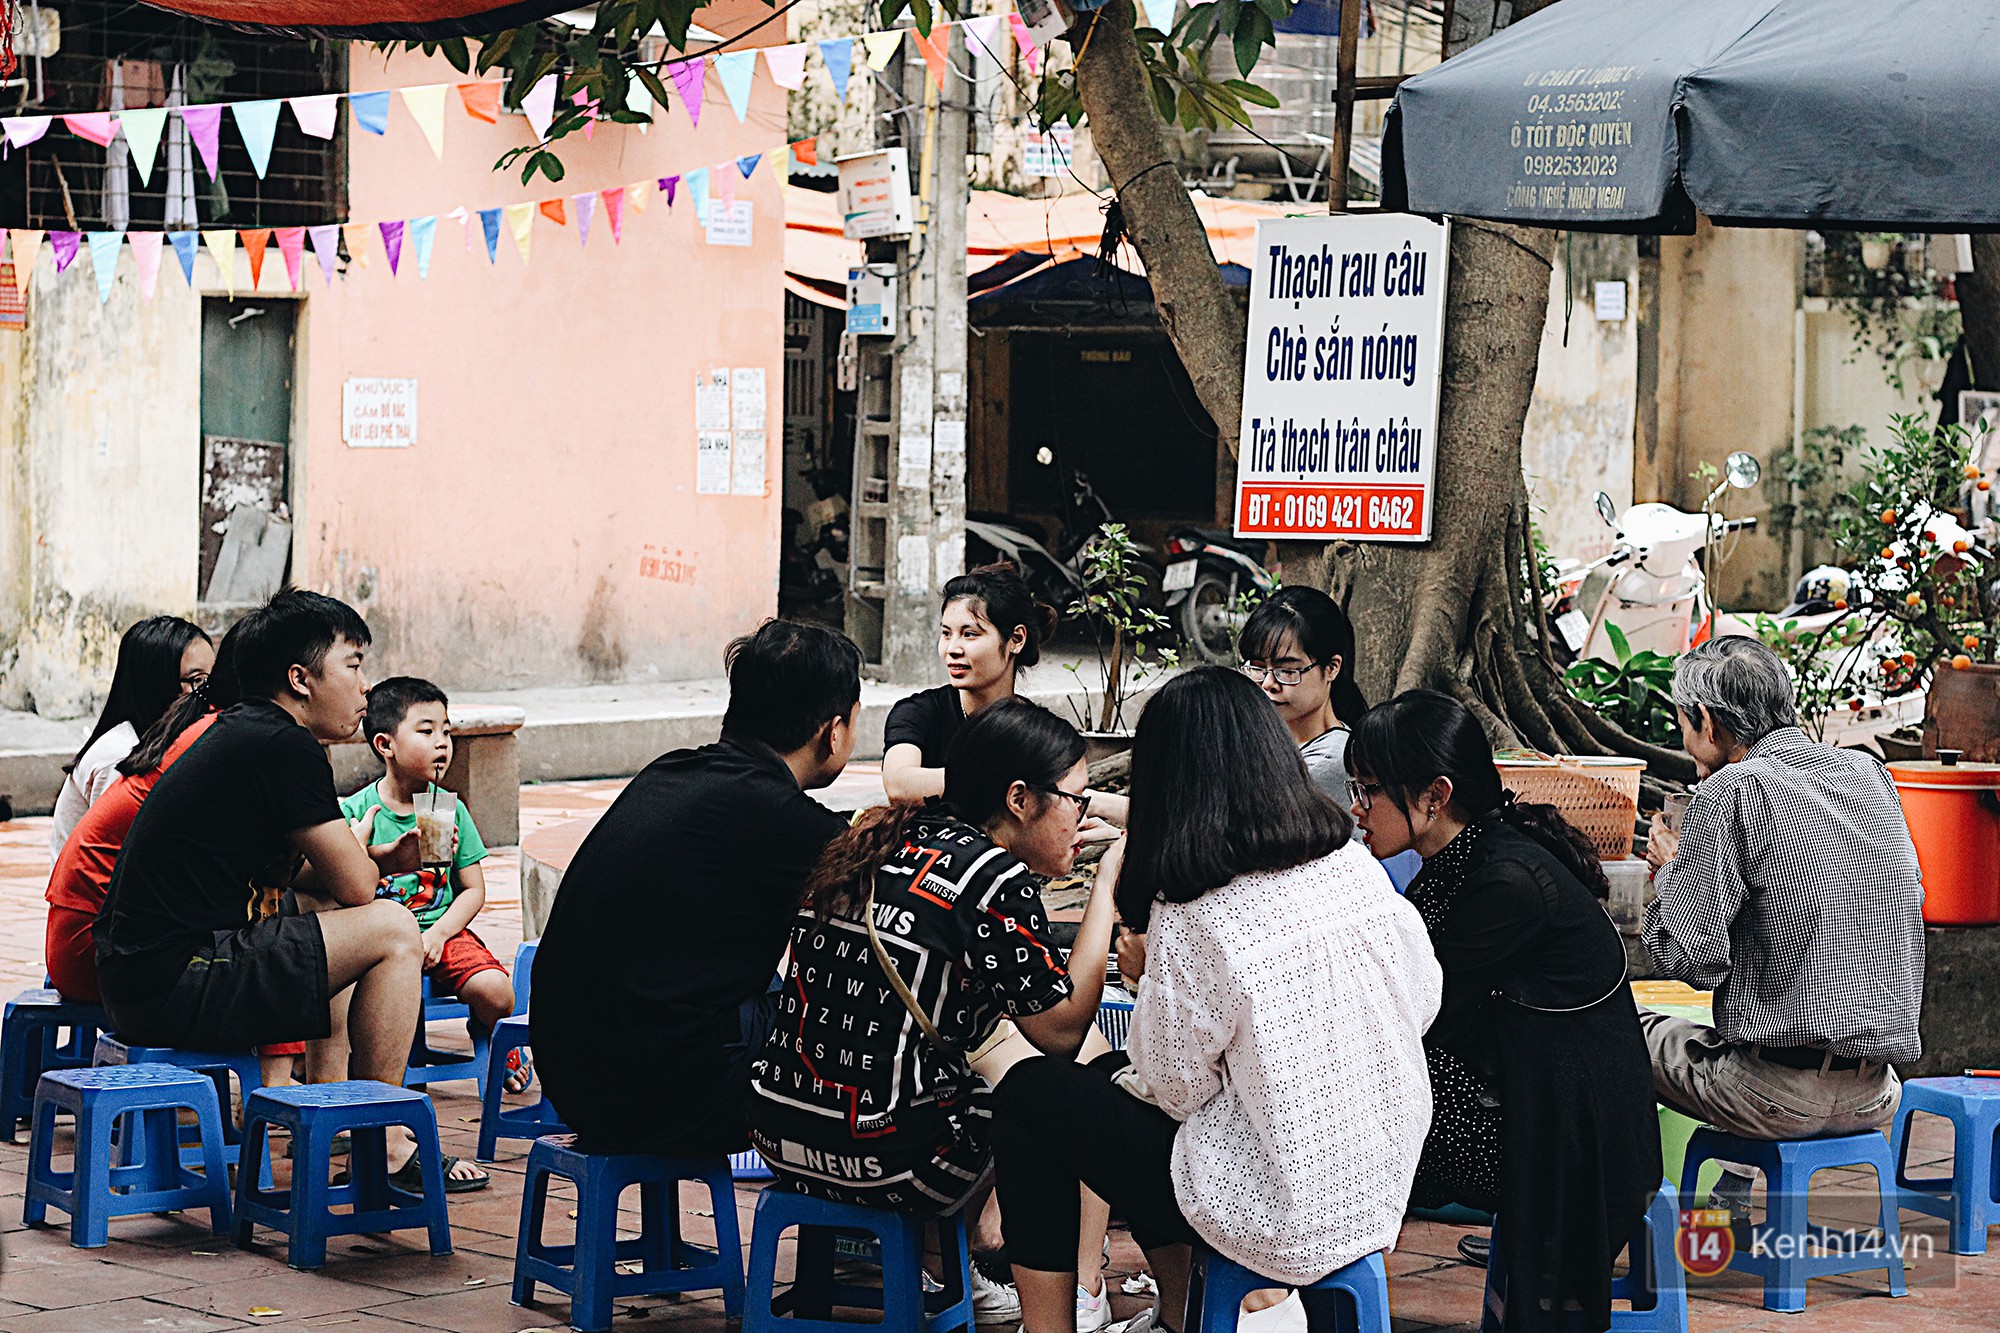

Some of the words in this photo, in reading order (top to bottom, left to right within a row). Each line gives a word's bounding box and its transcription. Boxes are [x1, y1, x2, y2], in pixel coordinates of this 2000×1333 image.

[1526, 115, 1553, 148] TỐT
[1556, 119, 1586, 152] ĐỘC
[1524, 155, 1617, 177] 0982532023
[1506, 180, 1537, 208] CÔNG
[1268, 243, 1334, 310] Thạch
[1338, 251, 1377, 298] rau
[1383, 240, 1427, 298] câu
[1266, 324, 1307, 382] Chè
[1313, 314, 1352, 382] sắn
[1360, 322, 1418, 387] nóng
[1250, 416, 1276, 473] Trà
[1280, 417, 1330, 481] thạch
[1336, 416, 1370, 473] trân
[1375, 416, 1422, 474] châu
[1248, 493, 1270, 527] ĐT
[1284, 493, 1327, 528] 0169
[1331, 495, 1362, 529] 421
[1368, 495, 1414, 529] 6462
[919, 878, 958, 902] FINISH
[857, 1114, 893, 1130] FINISH
[753, 1129, 778, 1152] START
[806, 1147, 883, 1179] NEWS
